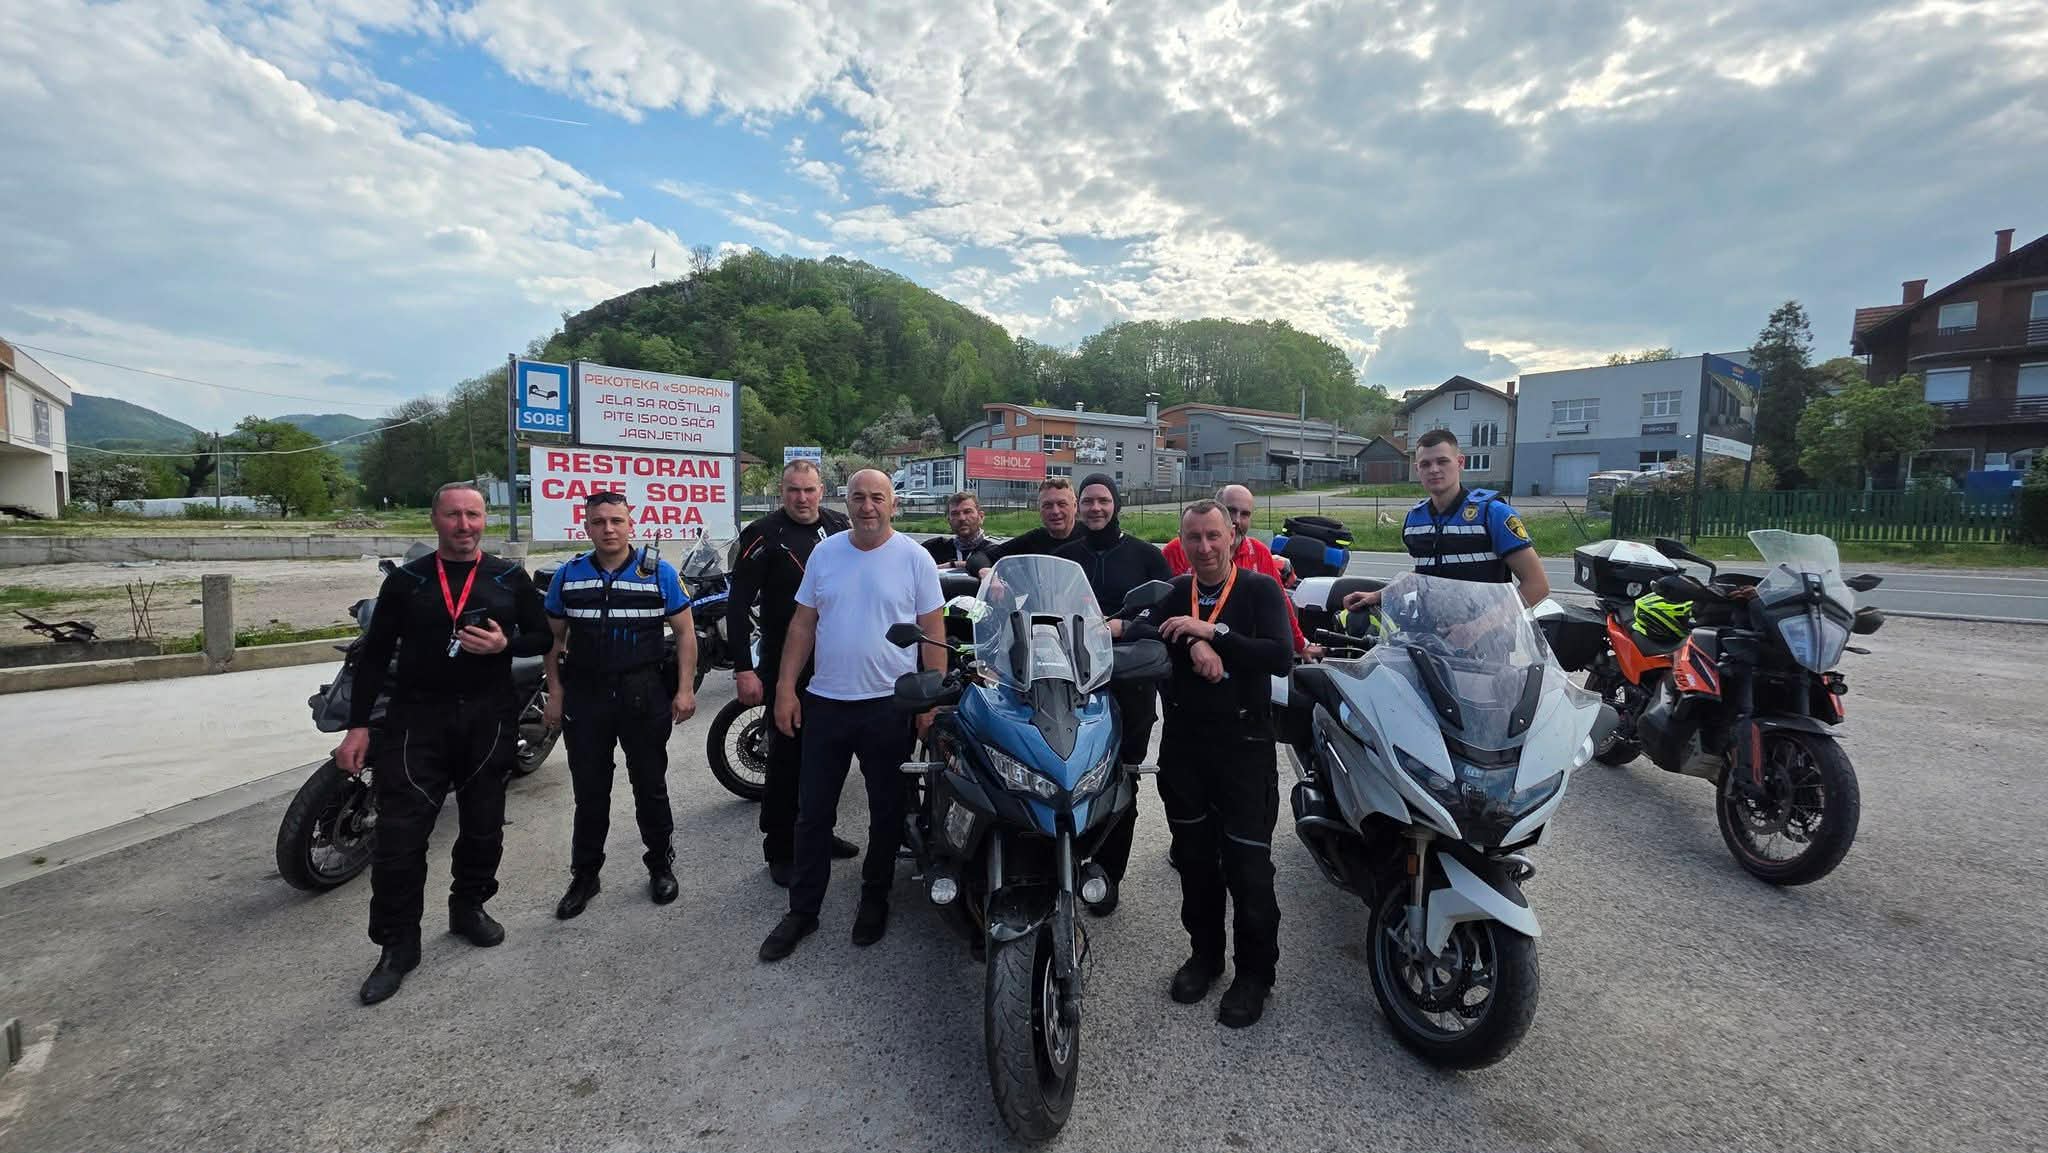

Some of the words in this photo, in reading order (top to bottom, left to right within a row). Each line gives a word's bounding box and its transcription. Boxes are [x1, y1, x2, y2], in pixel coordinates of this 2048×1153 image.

[584, 373, 659, 391] PEKOTEKA
[596, 394, 632, 407] JELA
[637, 397, 655, 409] SA
[659, 399, 720, 414] ROŠTILJA
[523, 411, 565, 426] SOBE
[603, 411, 634, 422] PITE
[638, 413, 678, 426] ISPOD
[681, 416, 715, 429] SAČA
[619, 428, 702, 443] JAGNJETINA
[547, 452, 720, 478] RESTORAN
[646, 482, 726, 503] SOBE
